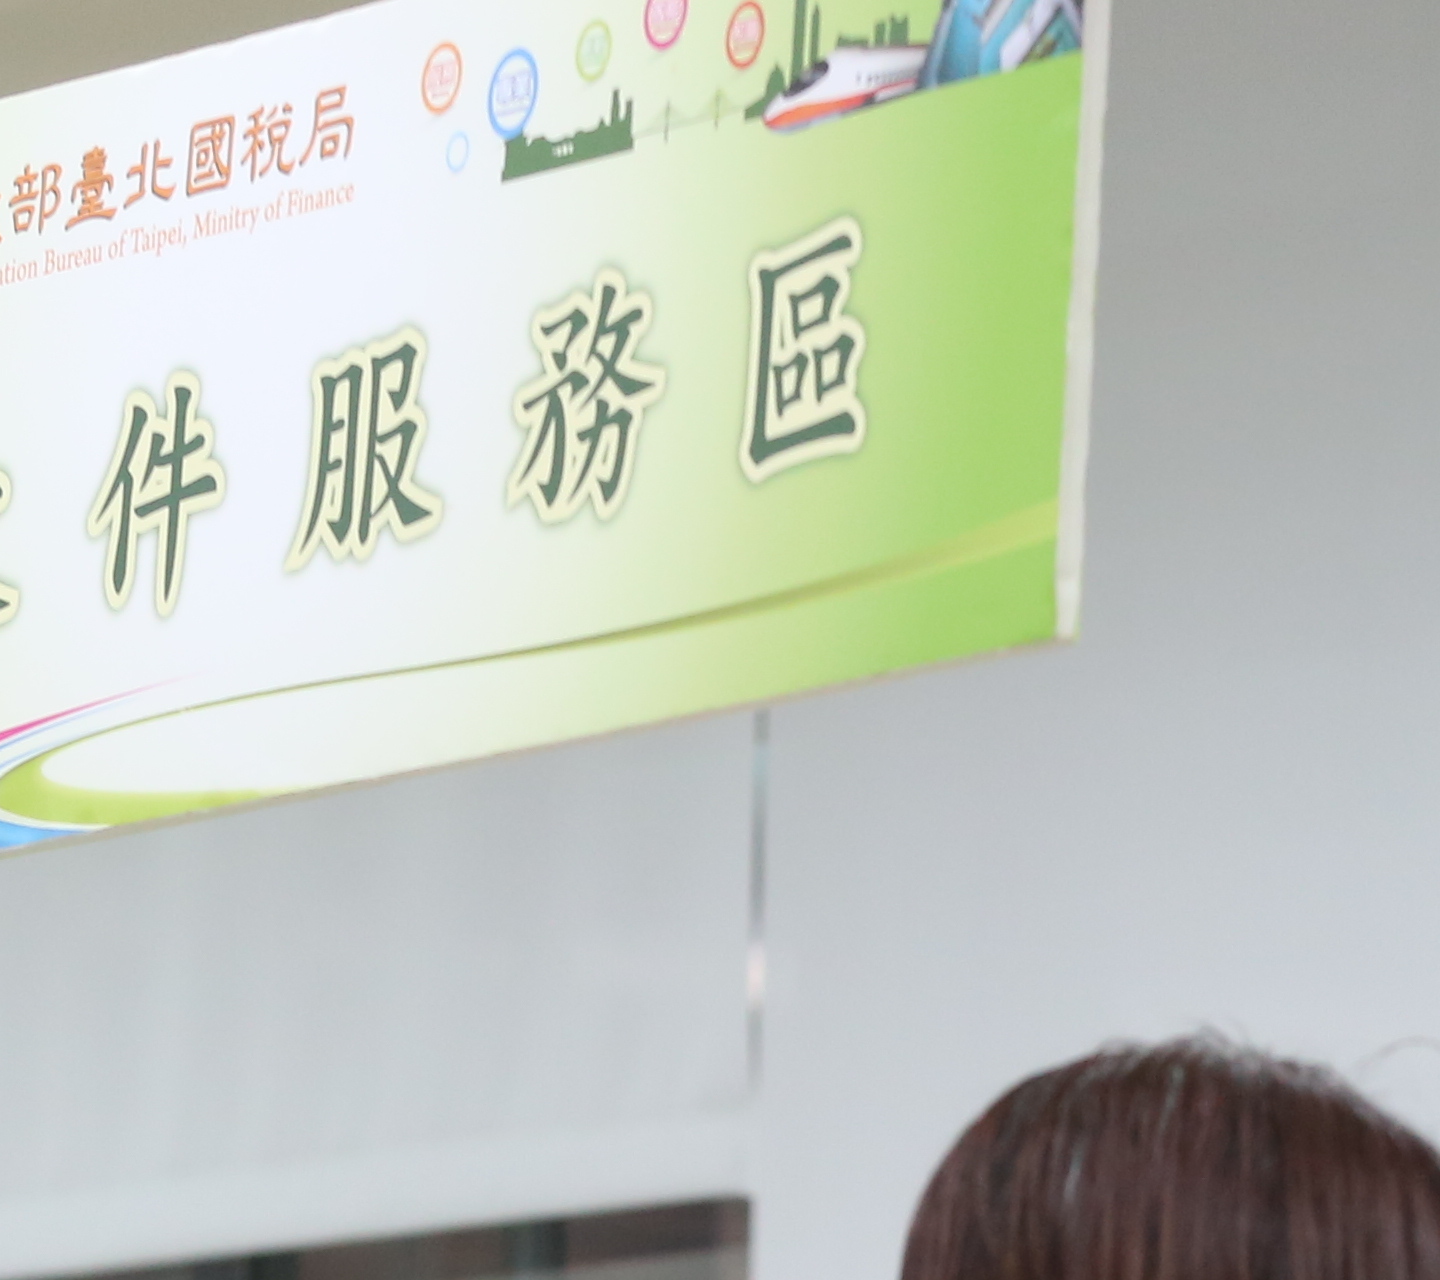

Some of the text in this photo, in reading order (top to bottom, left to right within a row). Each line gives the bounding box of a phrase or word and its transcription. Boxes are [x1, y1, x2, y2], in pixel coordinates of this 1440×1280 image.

[43, 243, 104, 277] Bureau
[108, 234, 128, 259] of
[131, 219, 188, 256] Taipei,
[264, 191, 286, 221] of
[288, 183, 356, 217] Finance
